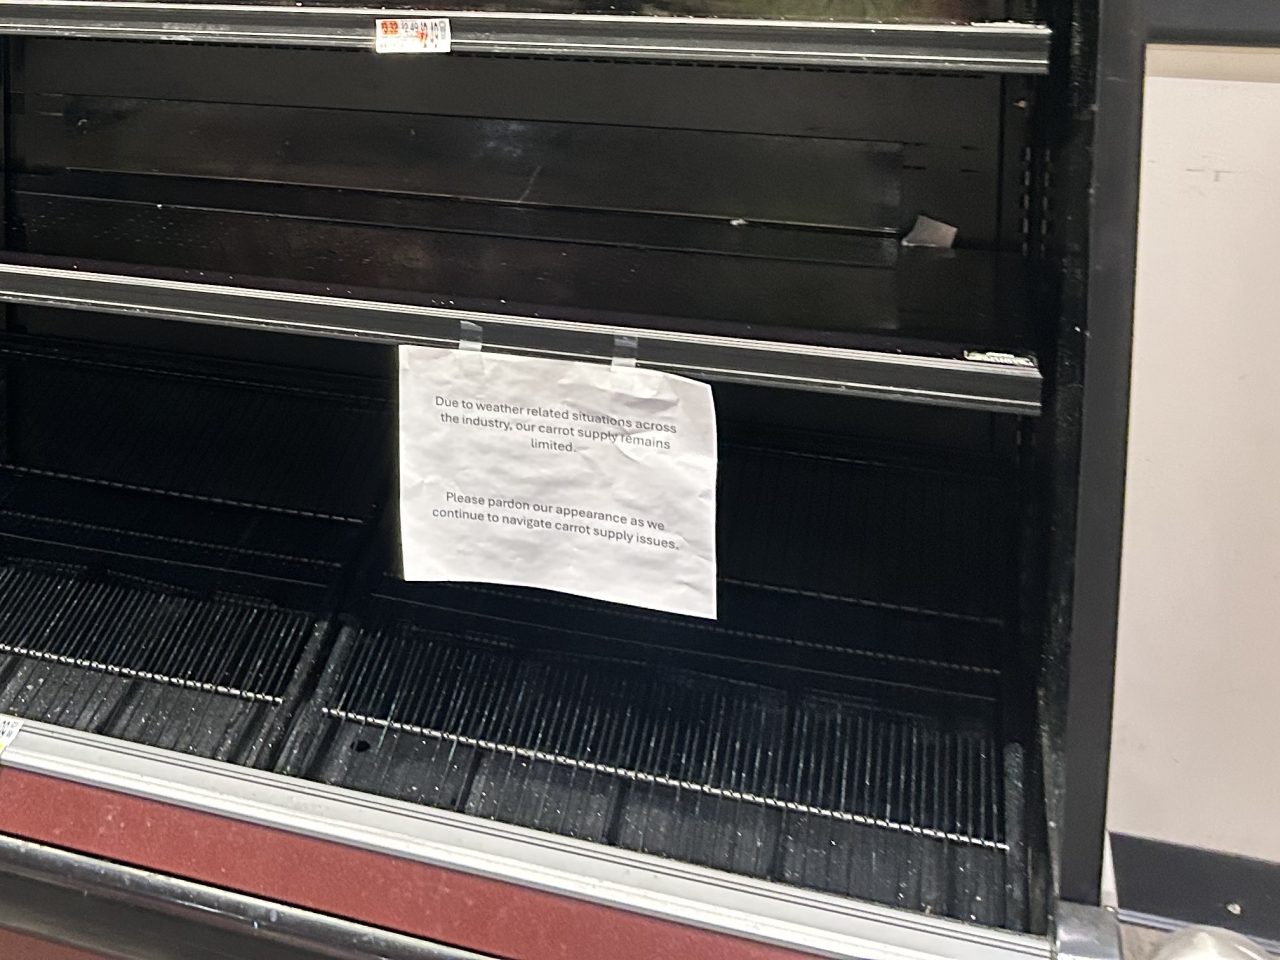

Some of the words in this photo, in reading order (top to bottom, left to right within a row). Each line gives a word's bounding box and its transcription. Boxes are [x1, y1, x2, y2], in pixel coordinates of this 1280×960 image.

[435, 396, 459, 407] Due
[462, 400, 473, 410] to
[476, 403, 525, 415] weather
[526, 407, 569, 420] related
[572, 412, 632, 428] situations
[635, 421, 677, 434] across
[440, 413, 460, 424] the
[462, 416, 513, 431] industry,
[515, 422, 535, 432] our
[538, 425, 575, 437] carrot
[577, 429, 618, 444] supply
[620, 434, 671, 450] remains
[531, 438, 577, 452] limited.
[432, 509, 485, 521] continue
[487, 513, 499, 523] to
[502, 515, 552, 529] navigate
[555, 522, 591, 535] carrot
[593, 527, 634, 543] supply
[636, 533, 680, 550] issues.
[446, 491, 485, 506] Please
[488, 498, 530, 510] pardon
[532, 503, 553, 513] our
[555, 506, 627, 524] appearance
[630, 517, 645, 528] as
[647, 520, 665, 531] we
